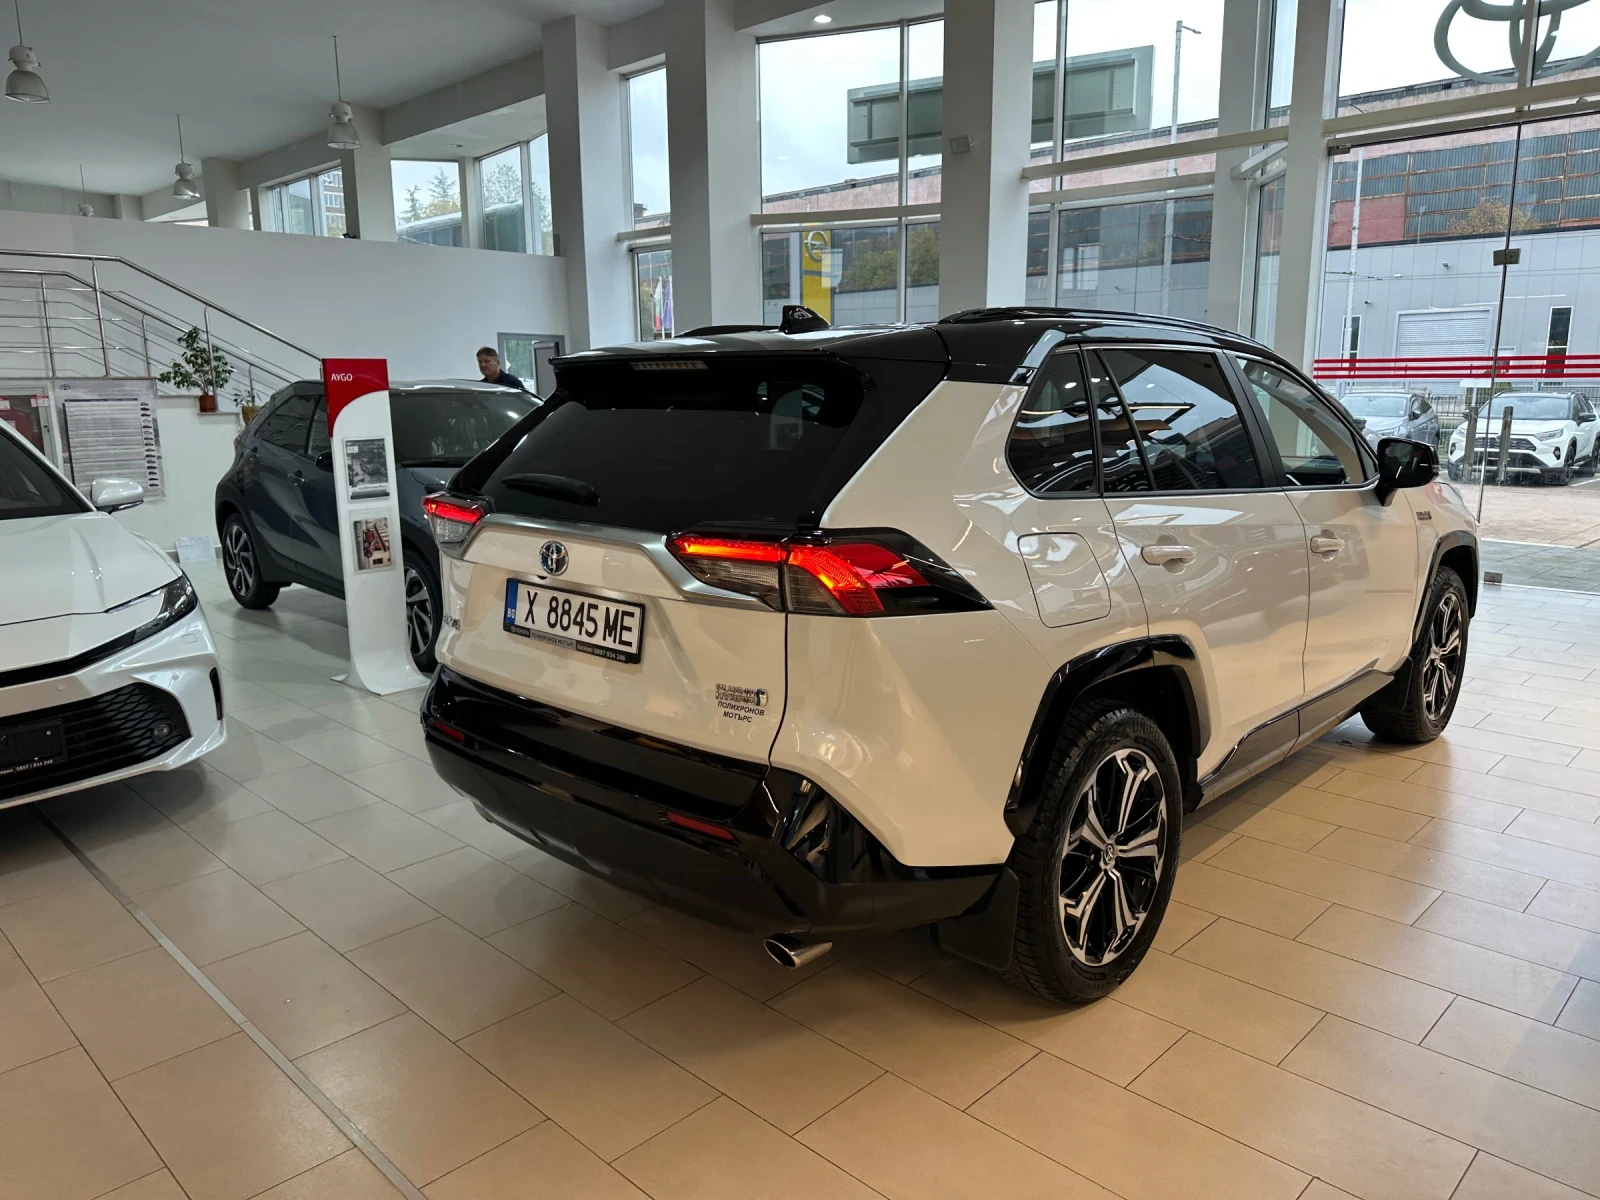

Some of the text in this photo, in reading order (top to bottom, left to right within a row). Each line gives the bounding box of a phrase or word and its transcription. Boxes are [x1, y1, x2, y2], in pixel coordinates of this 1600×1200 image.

[331, 373, 353, 381] AYGO
[507, 608, 515, 618] BG
[524, 590, 635, 647] X 8845 ME
[717, 701, 765, 716] ПОЛИХРОНОВ
[723, 710, 752, 723] МОТЪРС
